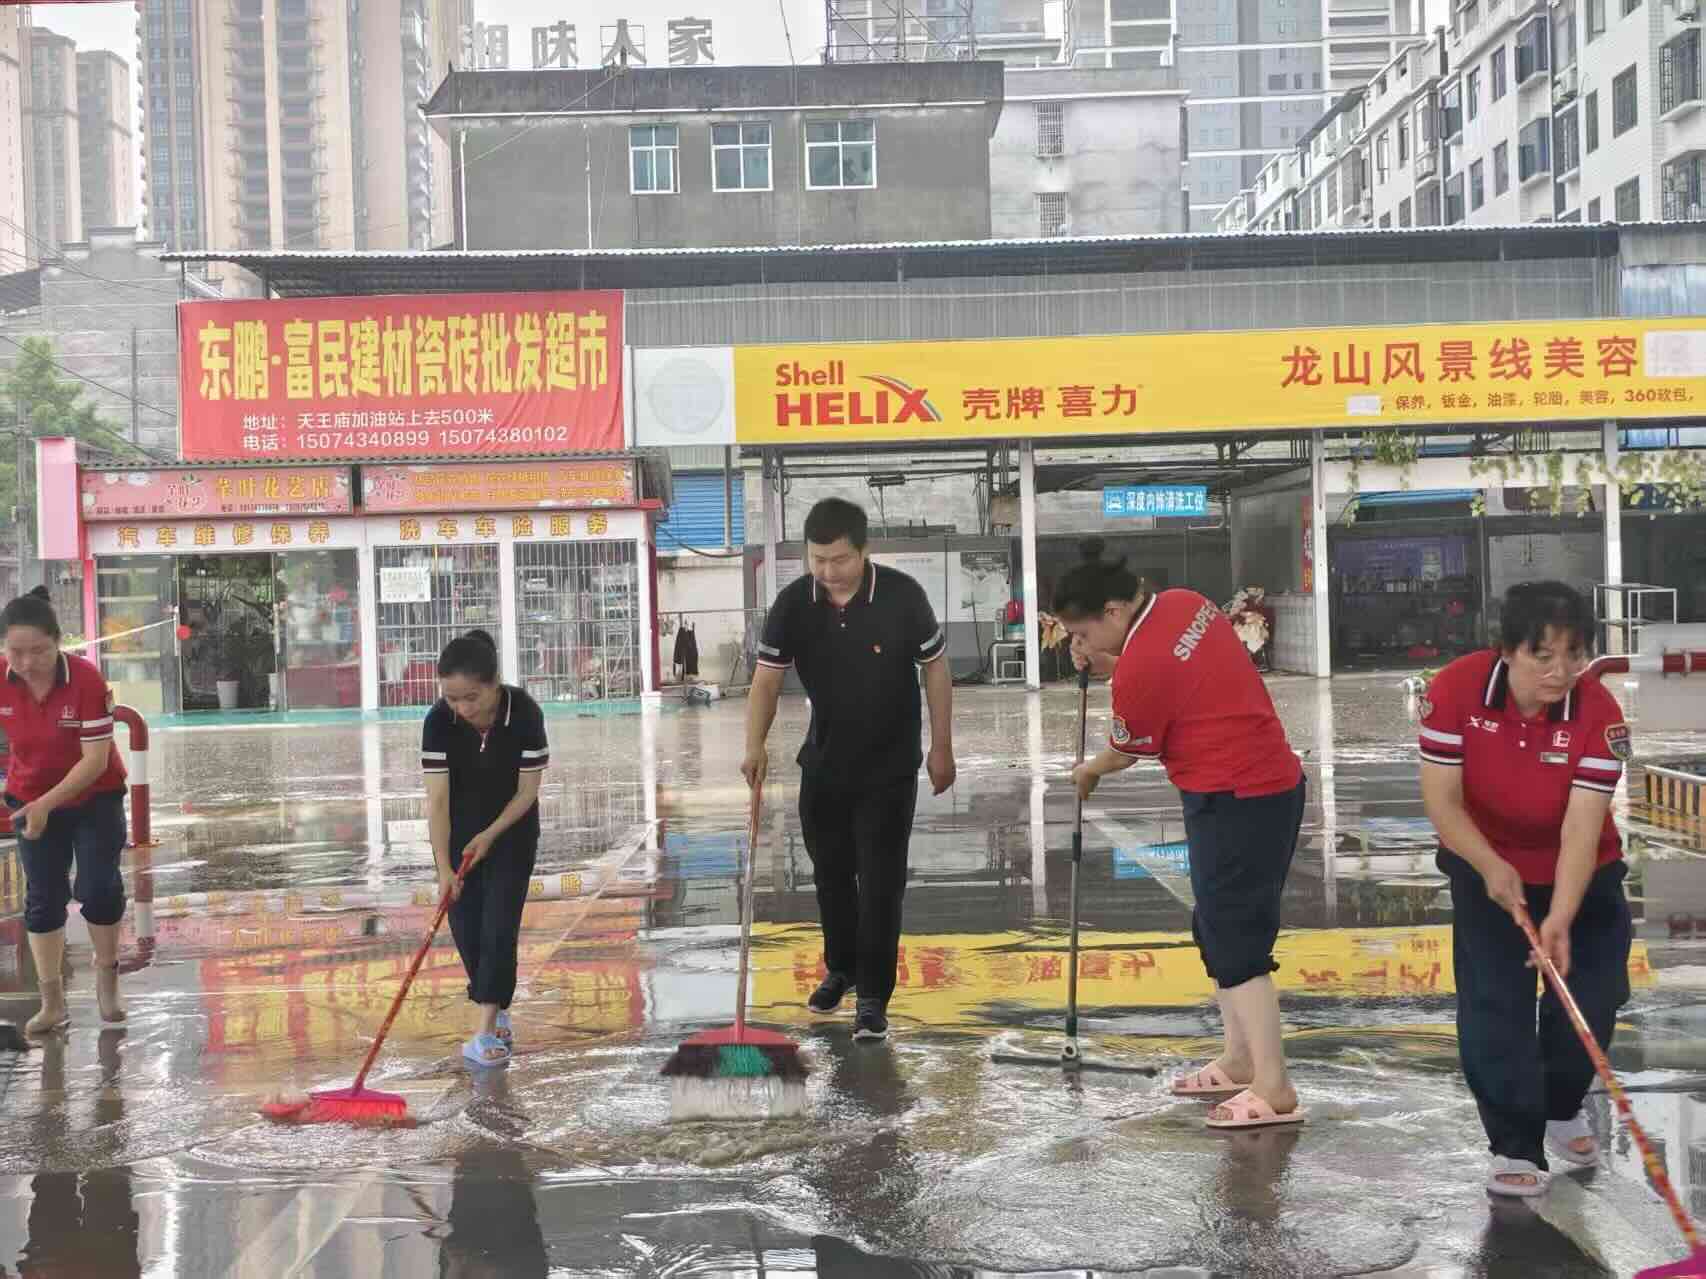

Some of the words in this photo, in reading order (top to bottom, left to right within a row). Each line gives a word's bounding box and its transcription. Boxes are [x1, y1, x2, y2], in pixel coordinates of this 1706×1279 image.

[775, 361, 844, 387] Shell
[1280, 335, 1638, 388] 龙山风景线美容
[776, 383, 940, 427] HELIX
[439, 425, 568, 446] 15074380102
[117, 520, 331, 546] 汽车维修保养
[399, 512, 608, 540] 洗车车险服务
